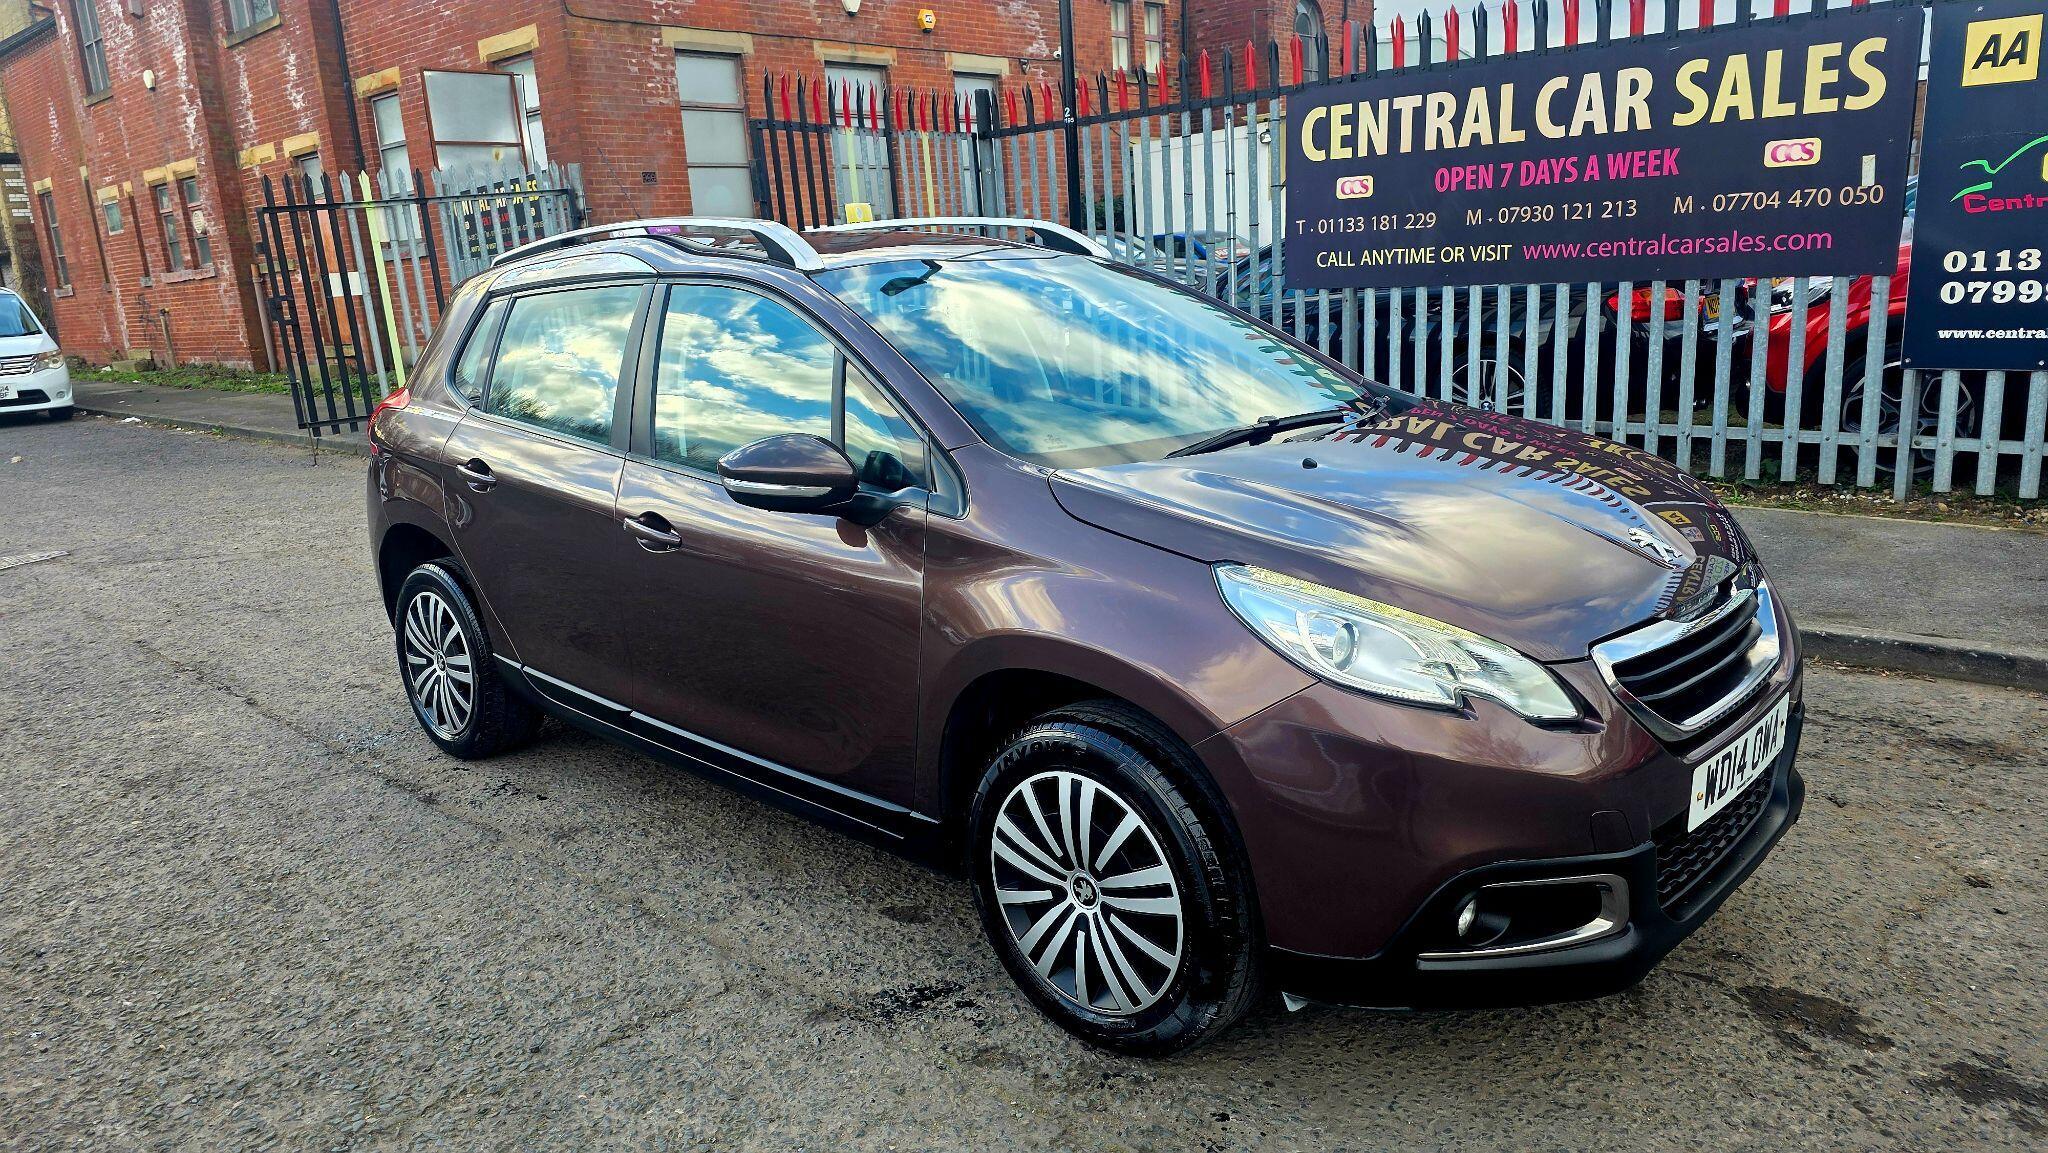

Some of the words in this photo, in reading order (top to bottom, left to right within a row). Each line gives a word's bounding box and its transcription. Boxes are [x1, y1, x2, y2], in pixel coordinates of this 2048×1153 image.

[1971, 30, 2030, 69] AA
[1301, 83, 1526, 162] CENTRAL
[1534, 67, 1654, 139] CAR
[1672, 37, 1888, 126] SALES
[1434, 164, 1493, 193] OPEN
[1500, 163, 1514, 188] 7
[1519, 156, 1578, 187] DAYS
[1584, 154, 1600, 182] A
[1607, 147, 1681, 180] WEEK
[1498, 205, 1554, 224] 07930
[1562, 202, 1592, 221] 121
[1601, 199, 1637, 219] 213
[1712, 190, 1780, 213] 07704
[1787, 187, 1832, 208] 470
[1839, 184, 1884, 206] 050
[1318, 216, 1365, 234] 01133
[1371, 214, 1398, 231] 181
[1403, 211, 1437, 230] 229
[1316, 251, 1355, 268] CALL
[1360, 247, 1436, 266] ANYTIME
[1440, 246, 1465, 263] OR
[1469, 244, 1513, 262] VISIT
[1522, 230, 1832, 260] www.centralcarsales.com
[1943, 248, 2042, 273] 0113
[1940, 280, 2048, 304] 0799
[1704, 737, 1748, 811] WD14
[1751, 708, 1780, 770] OWA
